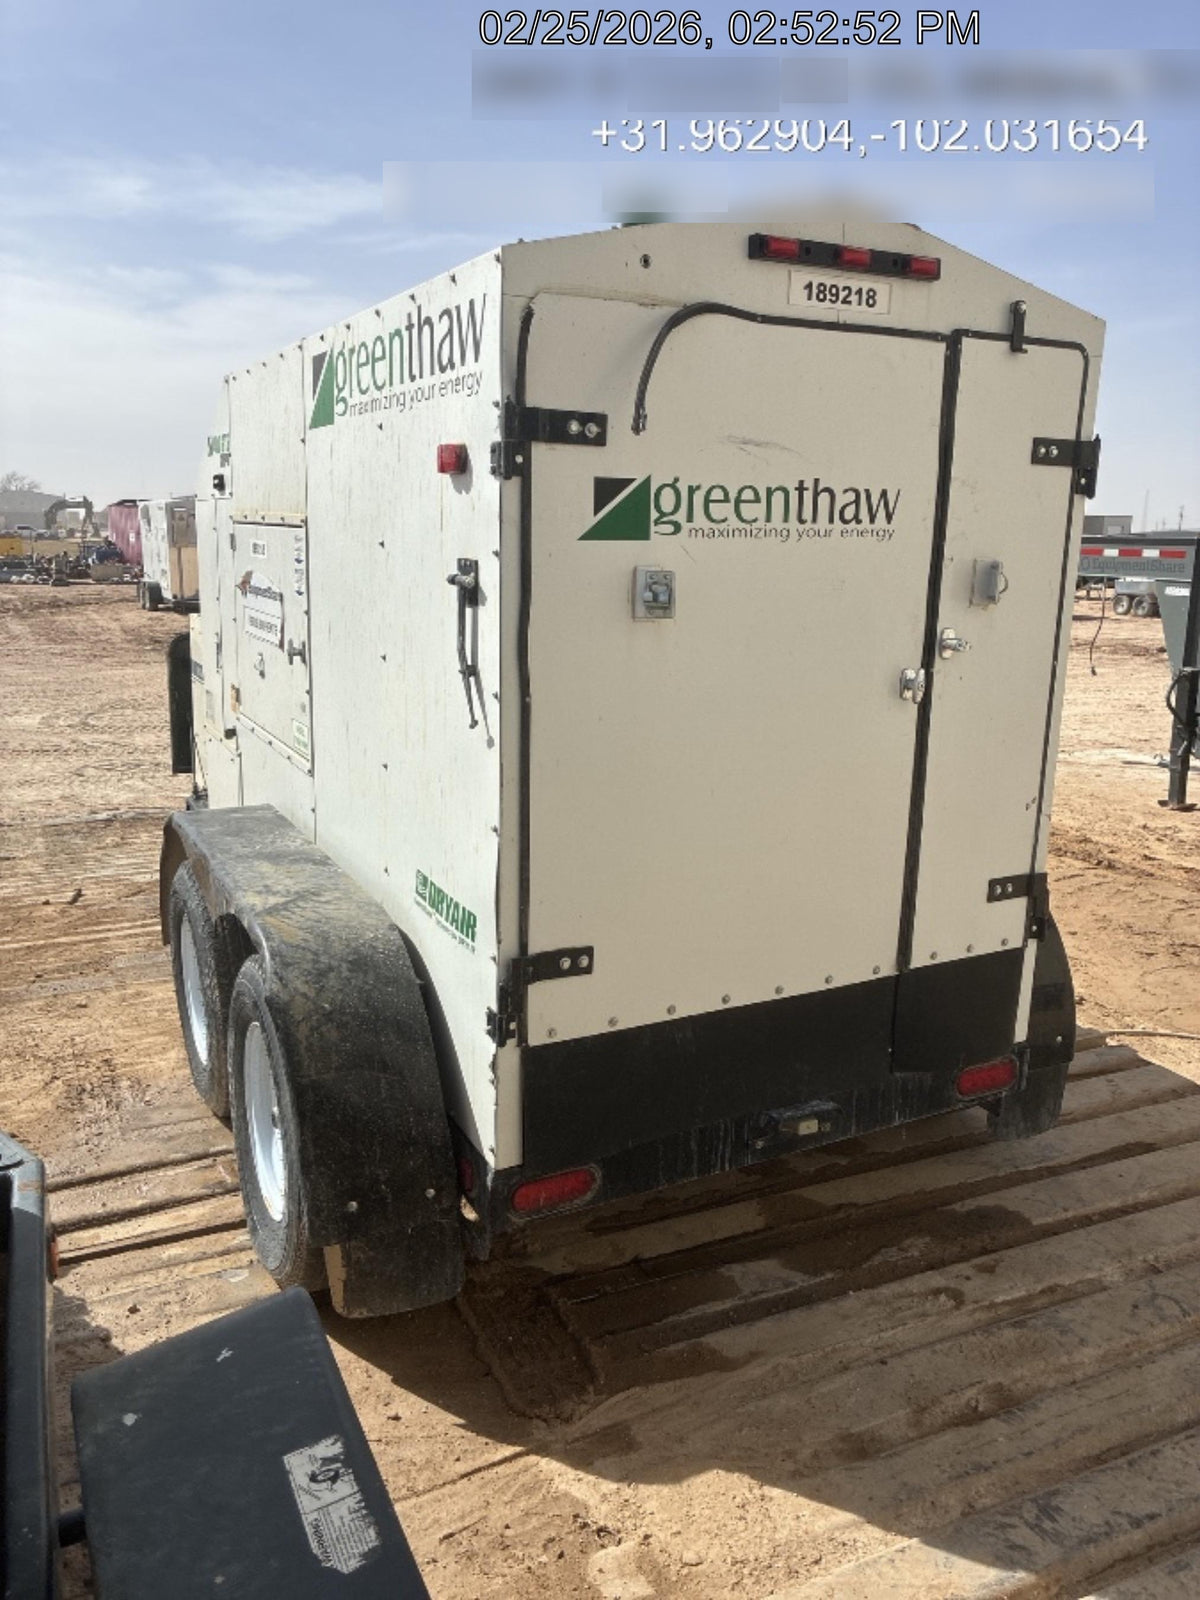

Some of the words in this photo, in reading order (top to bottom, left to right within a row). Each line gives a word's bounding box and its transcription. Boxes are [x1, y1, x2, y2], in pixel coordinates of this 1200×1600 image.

[803, 280, 877, 308] 189218
[334, 293, 487, 417] greenthaw
[408, 384, 437, 411] your
[438, 371, 483, 397] energy
[653, 476, 901, 536] greenthaw
[688, 523, 791, 543] maximizing
[796, 526, 834, 543] your
[840, 526, 896, 543] energy
[428, 878, 478, 943] DRYAIR
